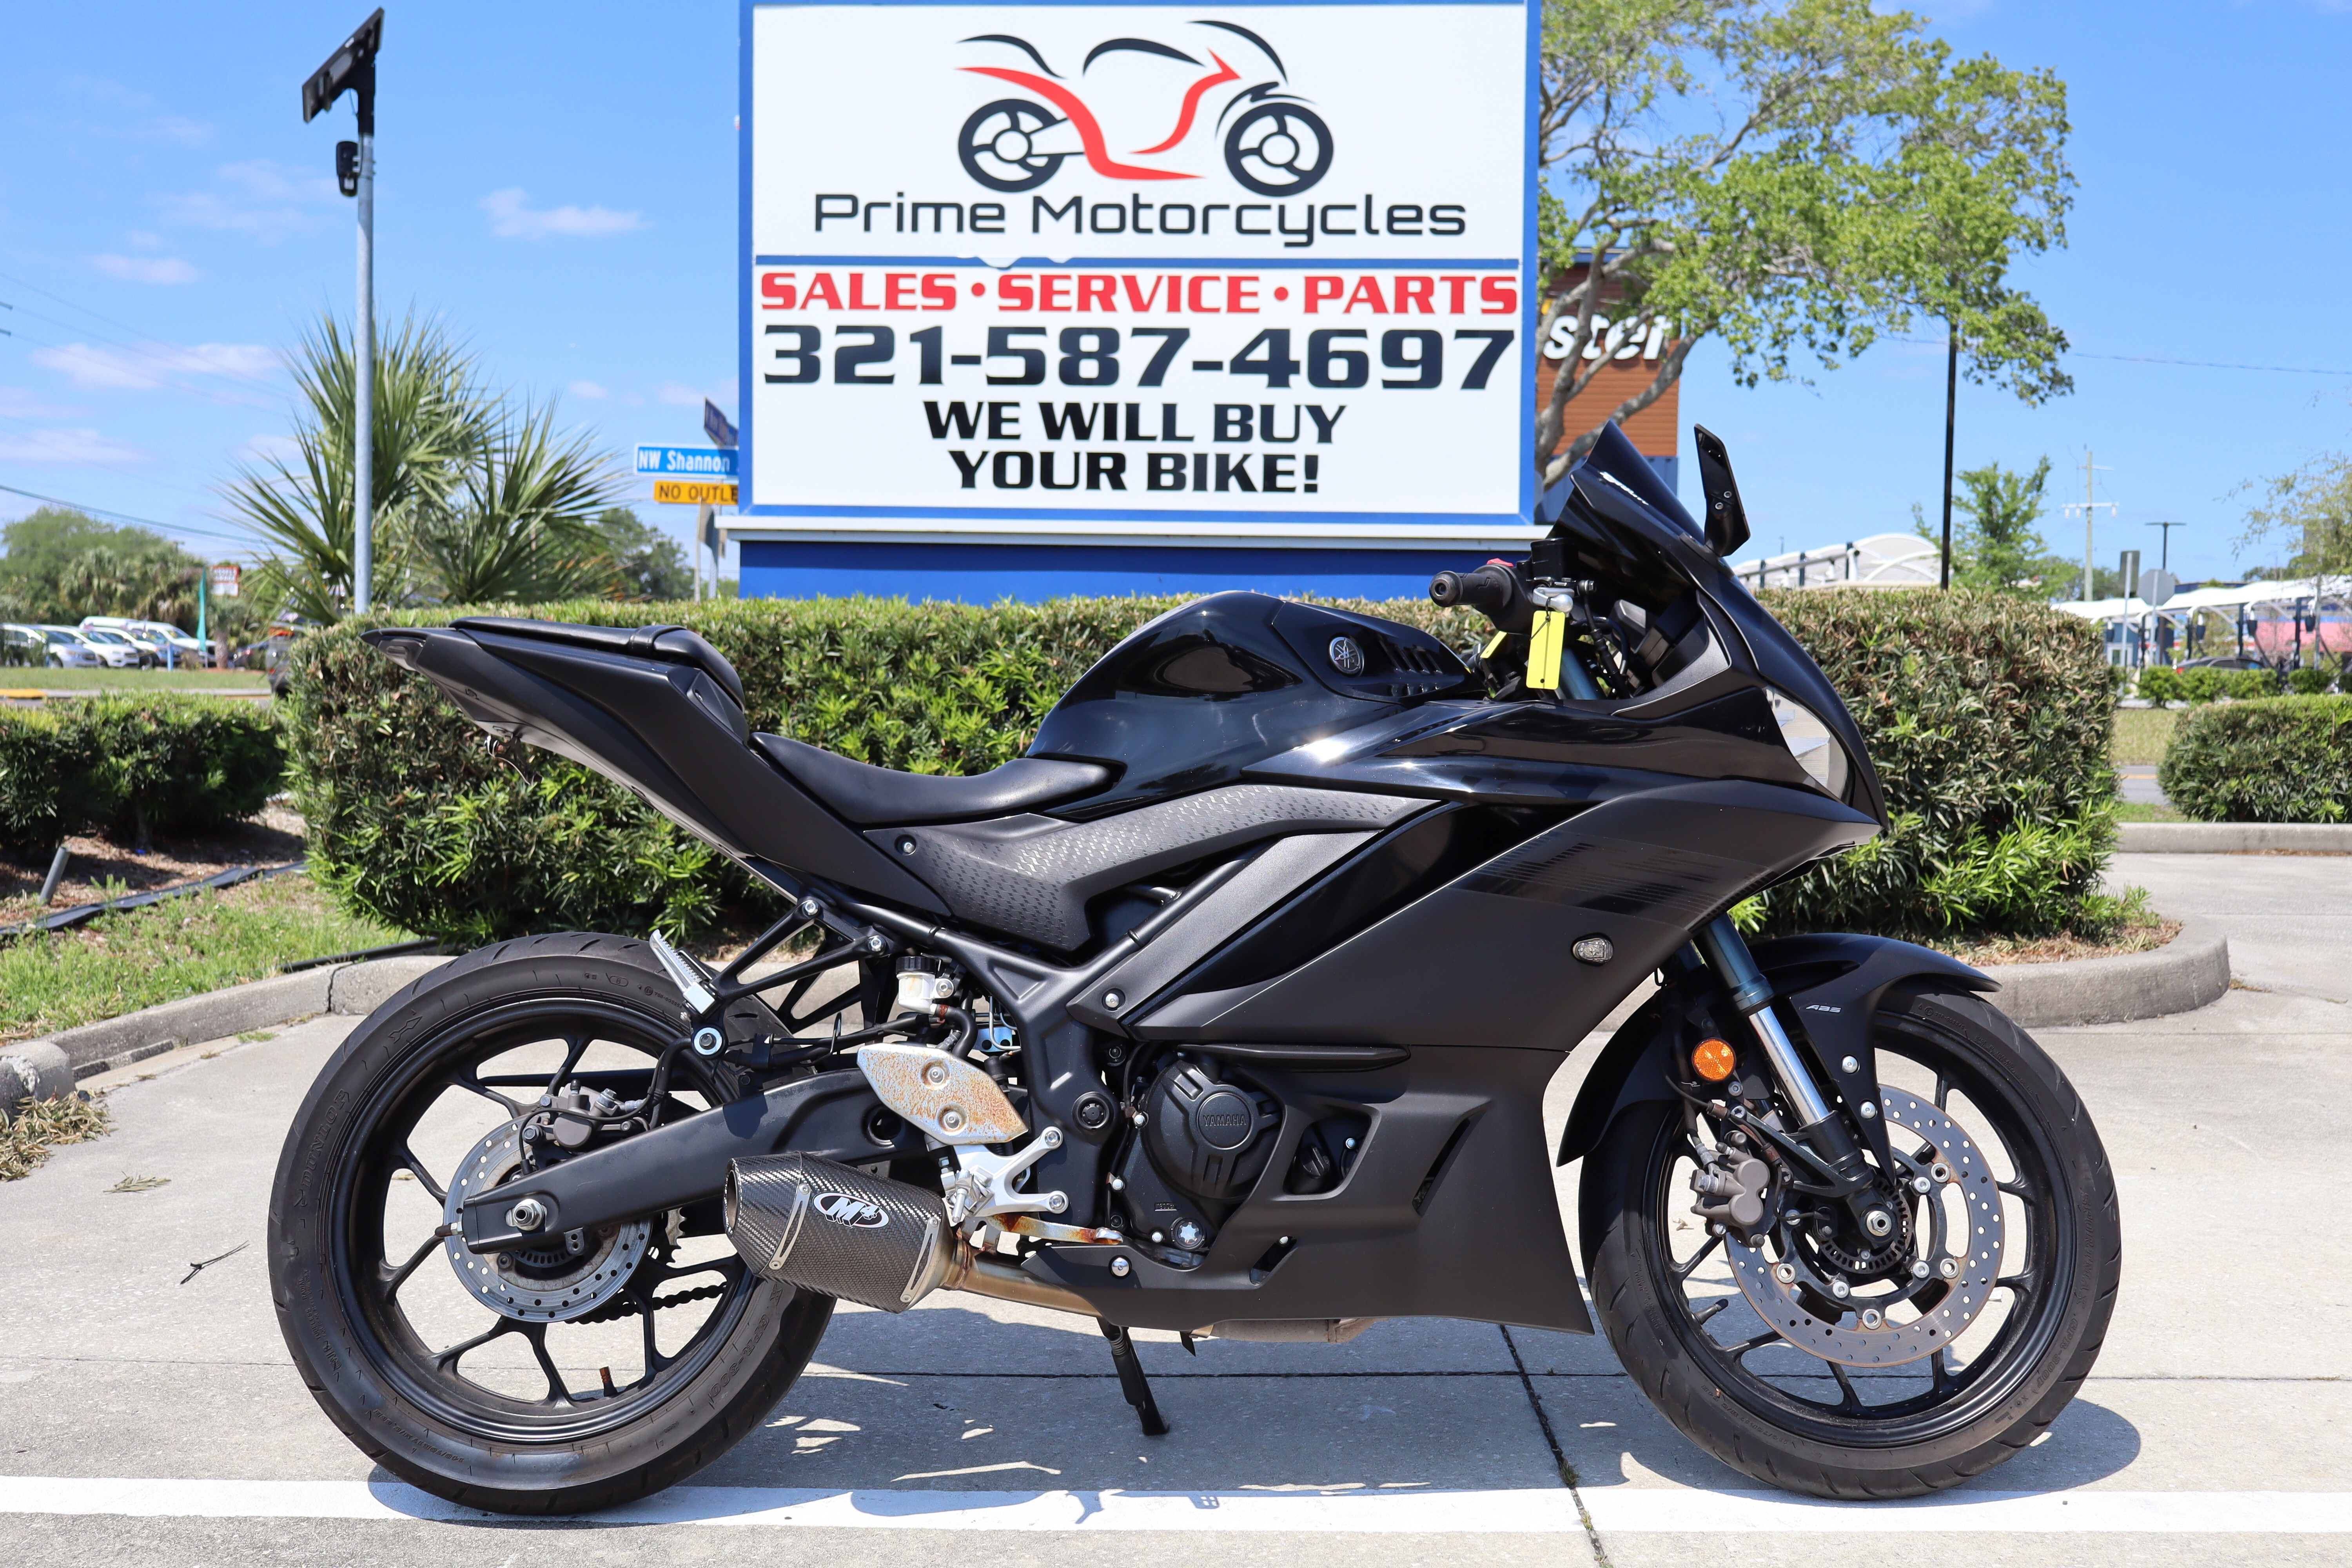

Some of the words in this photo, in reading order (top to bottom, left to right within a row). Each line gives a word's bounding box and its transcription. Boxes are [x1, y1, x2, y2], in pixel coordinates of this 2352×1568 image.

[815, 191, 1005, 233] Prime
[1032, 192, 1466, 248] Motorcycles
[761, 272, 957, 310] SALES
[998, 273, 1260, 313] SERVICE
[1304, 276, 1518, 314] PARTS
[764, 325, 1515, 390] 321-587-4697
[923, 401, 1021, 440] WE
[1038, 402, 1194, 441] WILL
[1213, 404, 1346, 444] BUY
[638, 450, 661, 470] NW
[667, 450, 730, 473] Shannon
[948, 450, 1127, 491] YOUR
[1147, 453, 1319, 493] BIKE!
[659, 485, 681, 500] NO
[1806, 1004, 1842, 1013] ABS
[301, 1088, 349, 1189] DUNLOP
[1203, 1114, 1247, 1127] YAMAHA
[824, 1196, 880, 1228] M4
[711, 1314, 770, 1399] GPR-300
